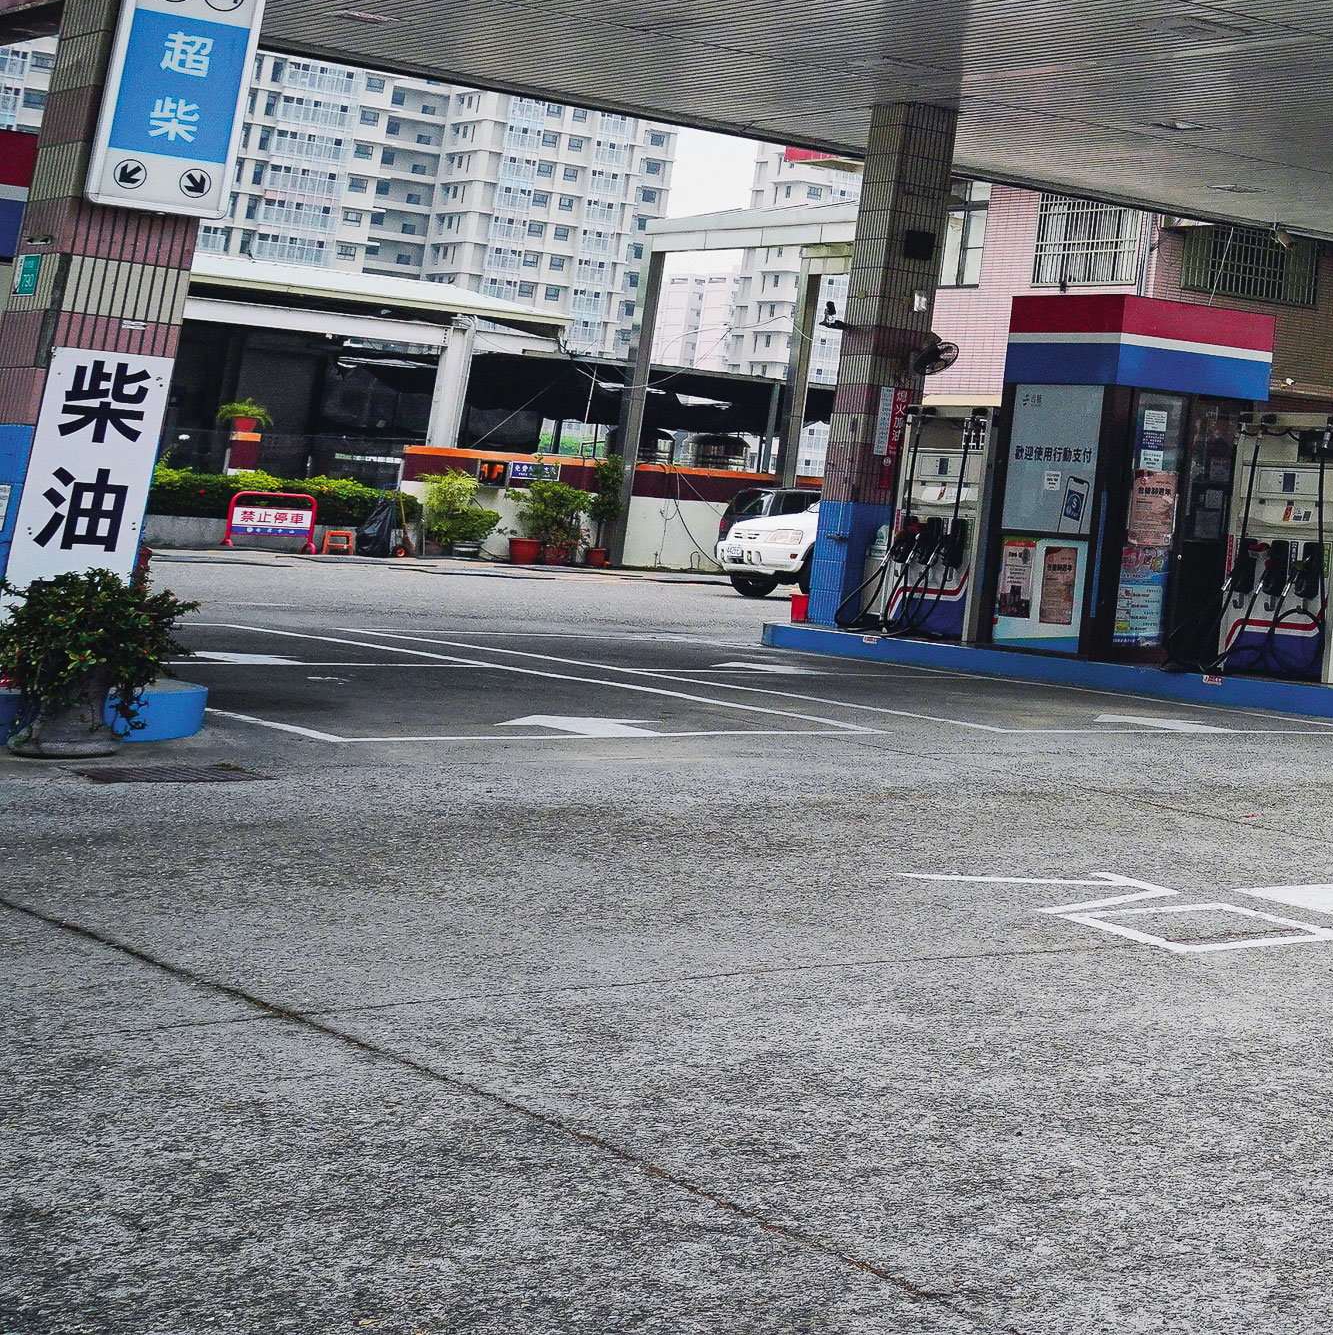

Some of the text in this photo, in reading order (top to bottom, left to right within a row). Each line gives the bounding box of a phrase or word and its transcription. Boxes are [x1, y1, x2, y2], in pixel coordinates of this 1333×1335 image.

[148, 30, 214, 144] 超柴
[33, 360, 150, 553] 柴油
[1014, 446, 1093, 464] 歡迎使用行動支付
[240, 510, 304, 525] 禁止停車
